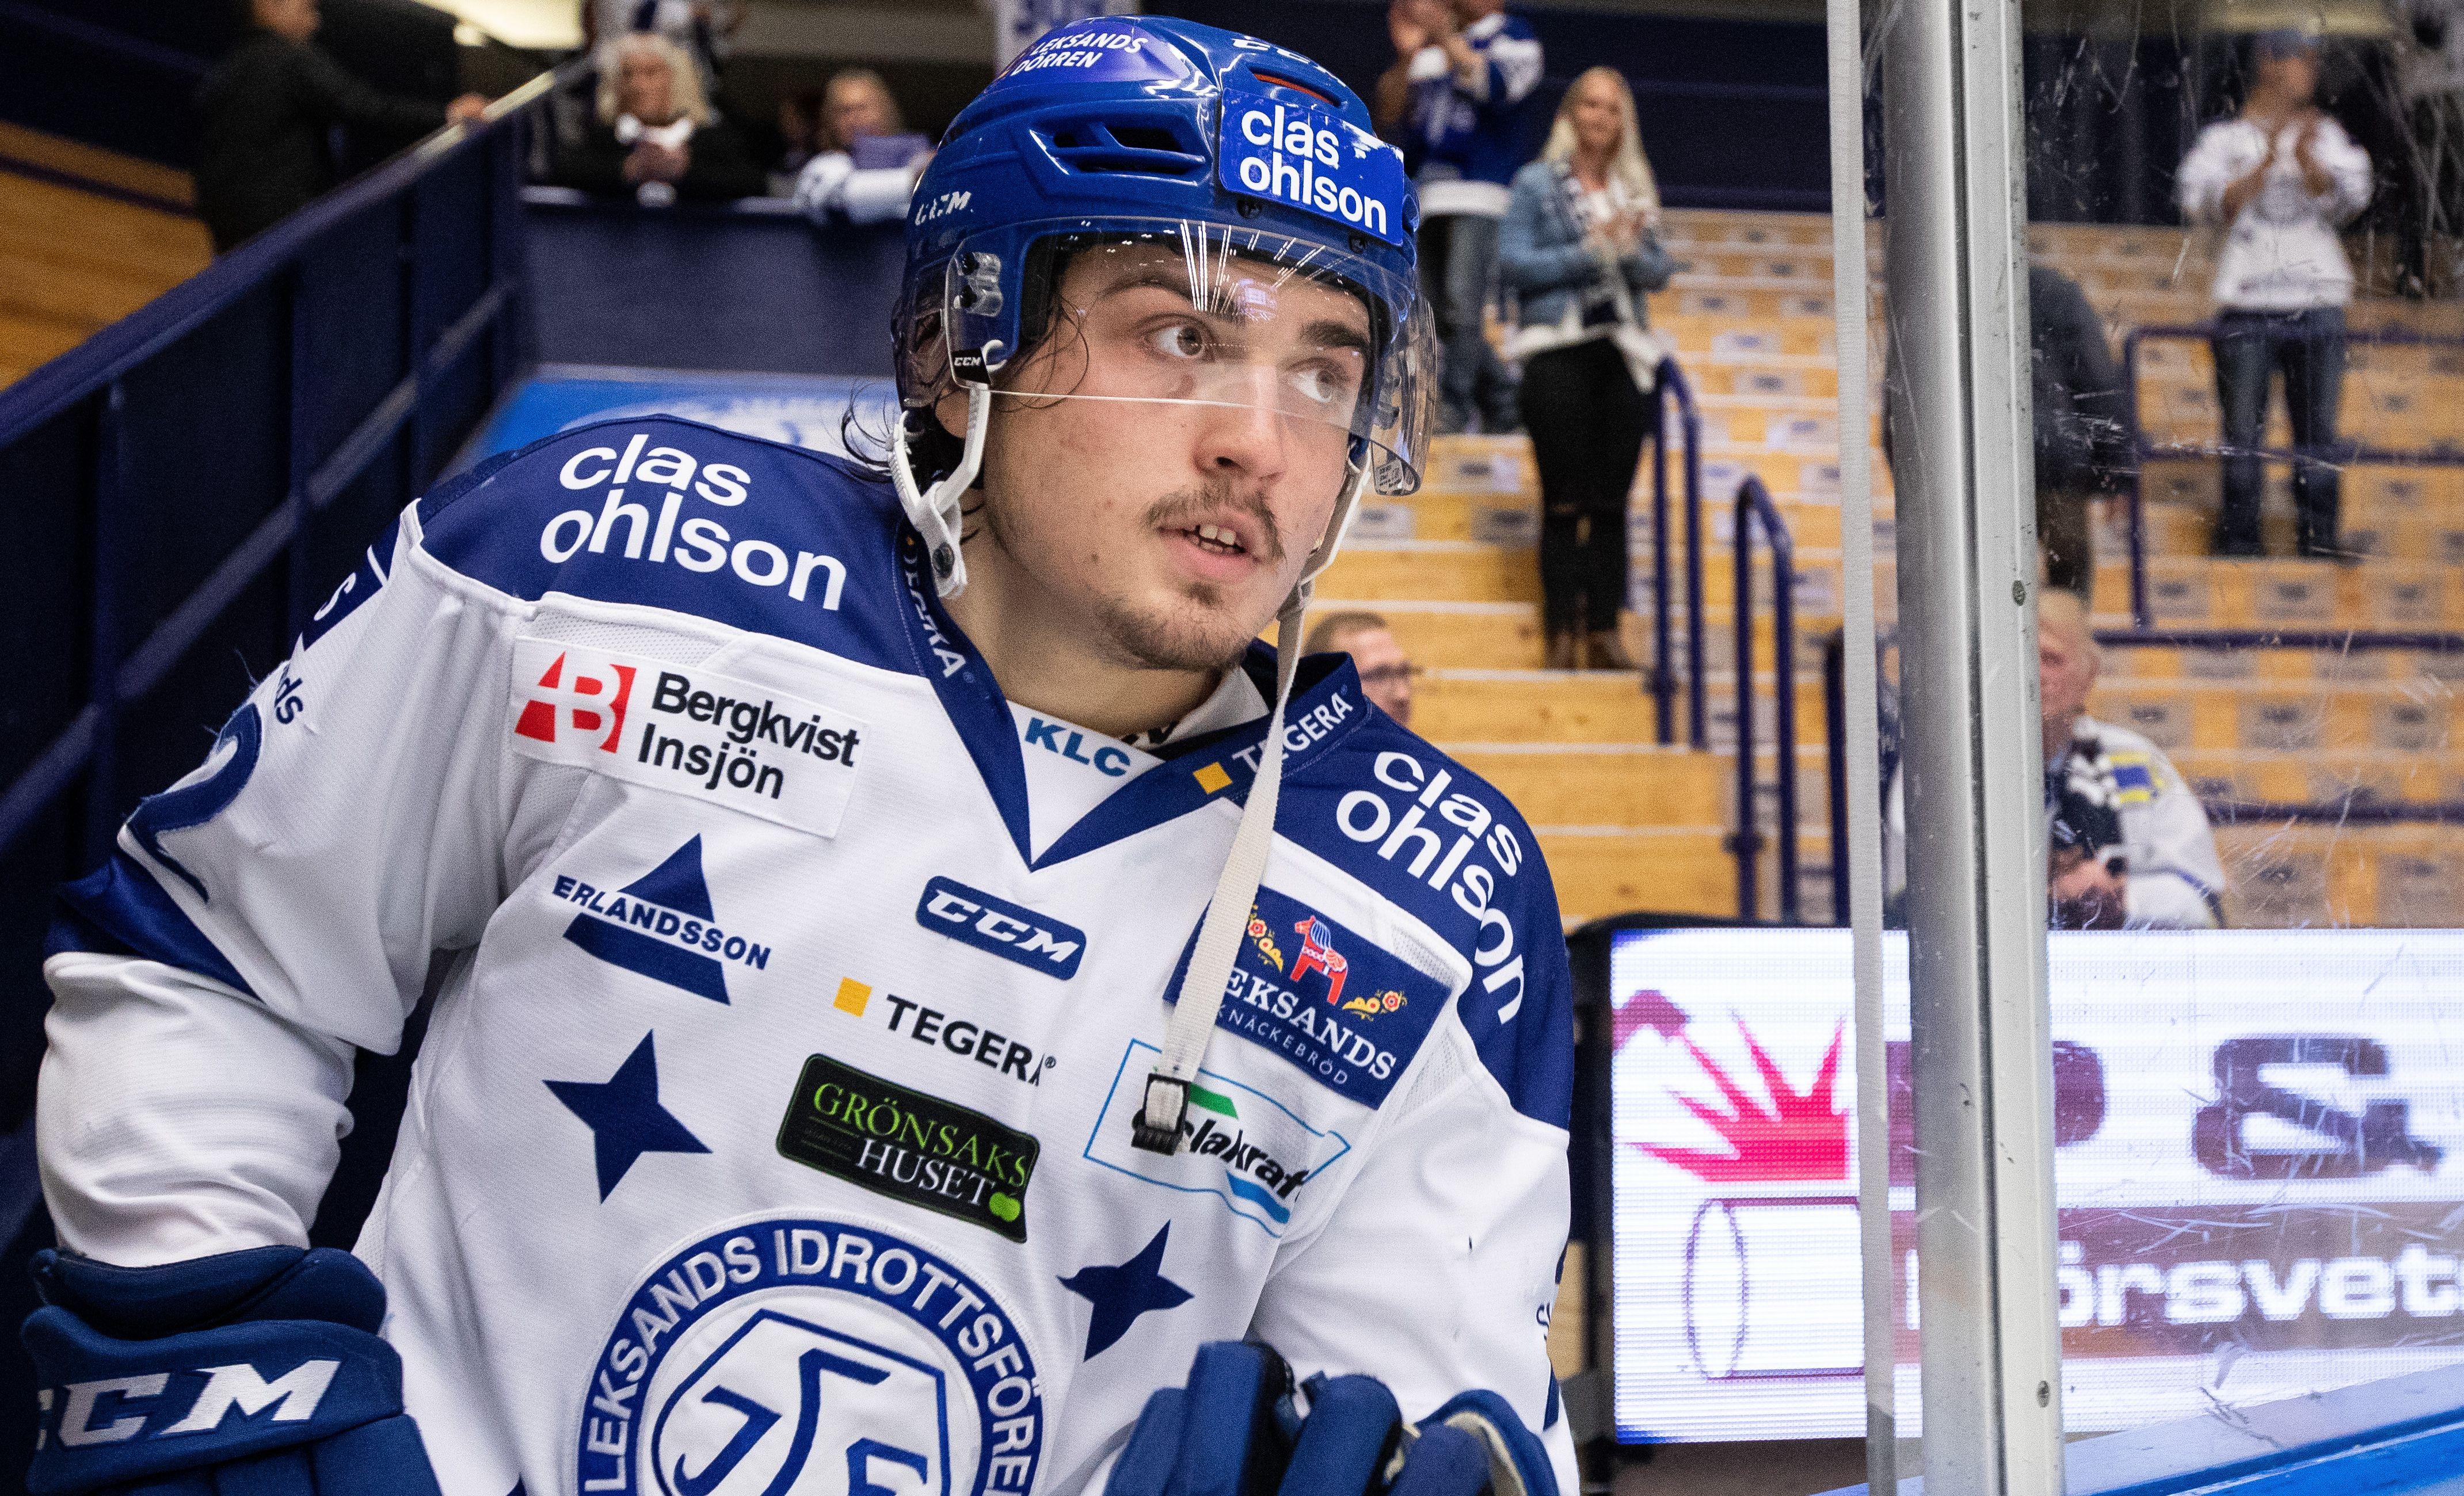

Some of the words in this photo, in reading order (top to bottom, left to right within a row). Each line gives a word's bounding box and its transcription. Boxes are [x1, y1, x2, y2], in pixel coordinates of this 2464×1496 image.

[1010, 51, 1103, 77] DÖRREN
[1030, 32, 1149, 56] LEKSANDS
[1241, 104, 1340, 168] clas
[1240, 151, 1387, 235] ohlson
[954, 356, 981, 367] CCM
[559, 434, 752, 507] clas
[540, 489, 847, 611] ohlson
[651, 671, 860, 768] Bergkvist
[1025, 717, 1131, 777] KLC
[637, 723, 784, 800] Insjön
[1374, 751, 1522, 866] clas
[551, 874, 771, 971] ERLANDSSON
[927, 889, 1080, 963] CCM
[1336, 790, 1525, 1025] ohlson
[1226, 967, 1397, 1080] EKSANDS
[813, 1082, 1027, 1188] GRÖNSAKS
[855, 1138, 996, 1205] HUSET
[584, 1235, 761, 1491] LEKSANDS
[774, 1228, 1041, 1496] IDROTTSFÖRE
